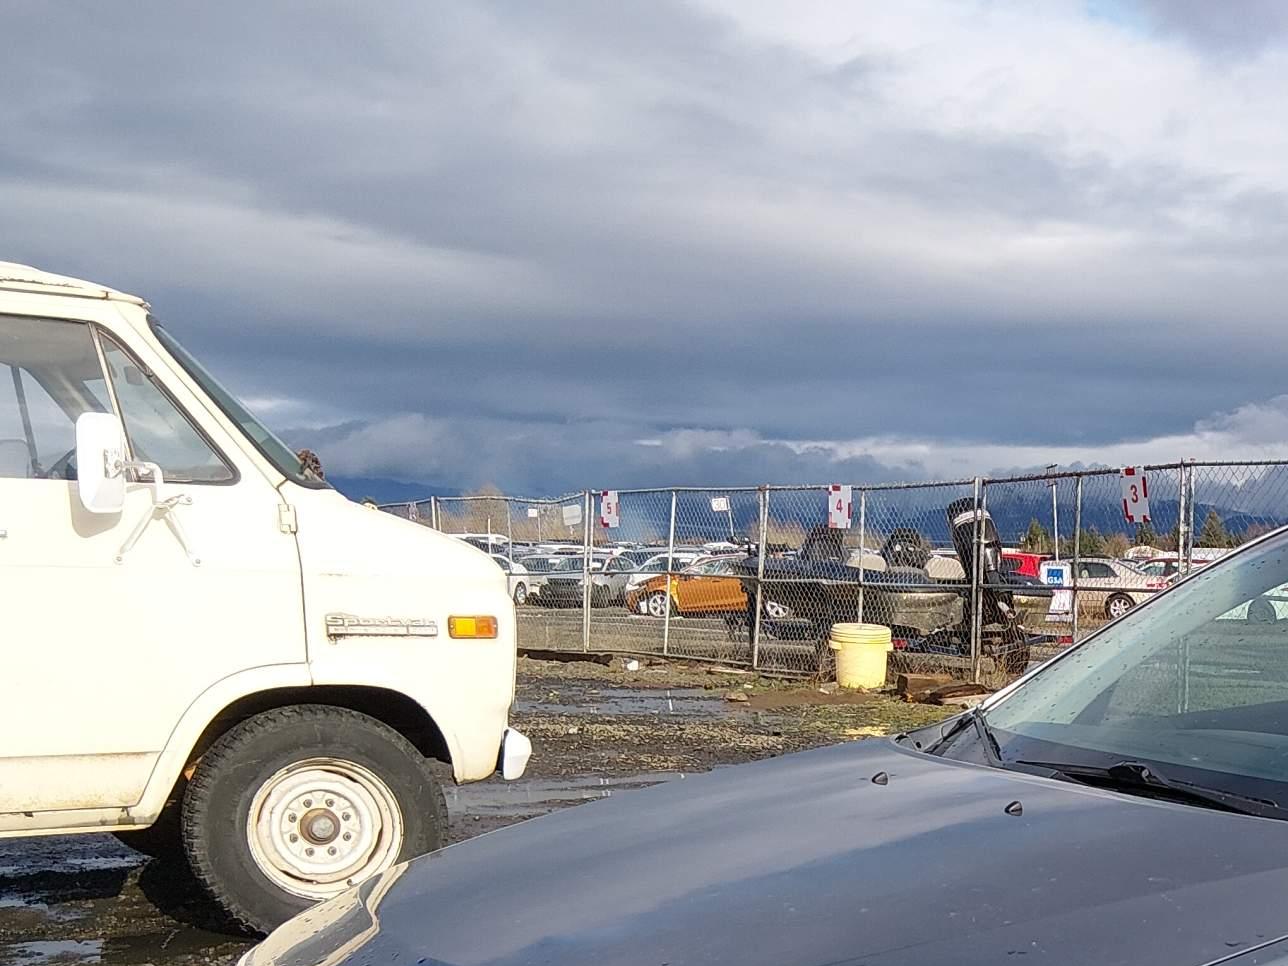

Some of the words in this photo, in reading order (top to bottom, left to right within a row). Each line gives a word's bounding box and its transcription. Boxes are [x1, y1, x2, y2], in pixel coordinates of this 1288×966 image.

[1130, 484, 1139, 504] 3
[606, 502, 612, 515] 5
[836, 498, 843, 513] 4
